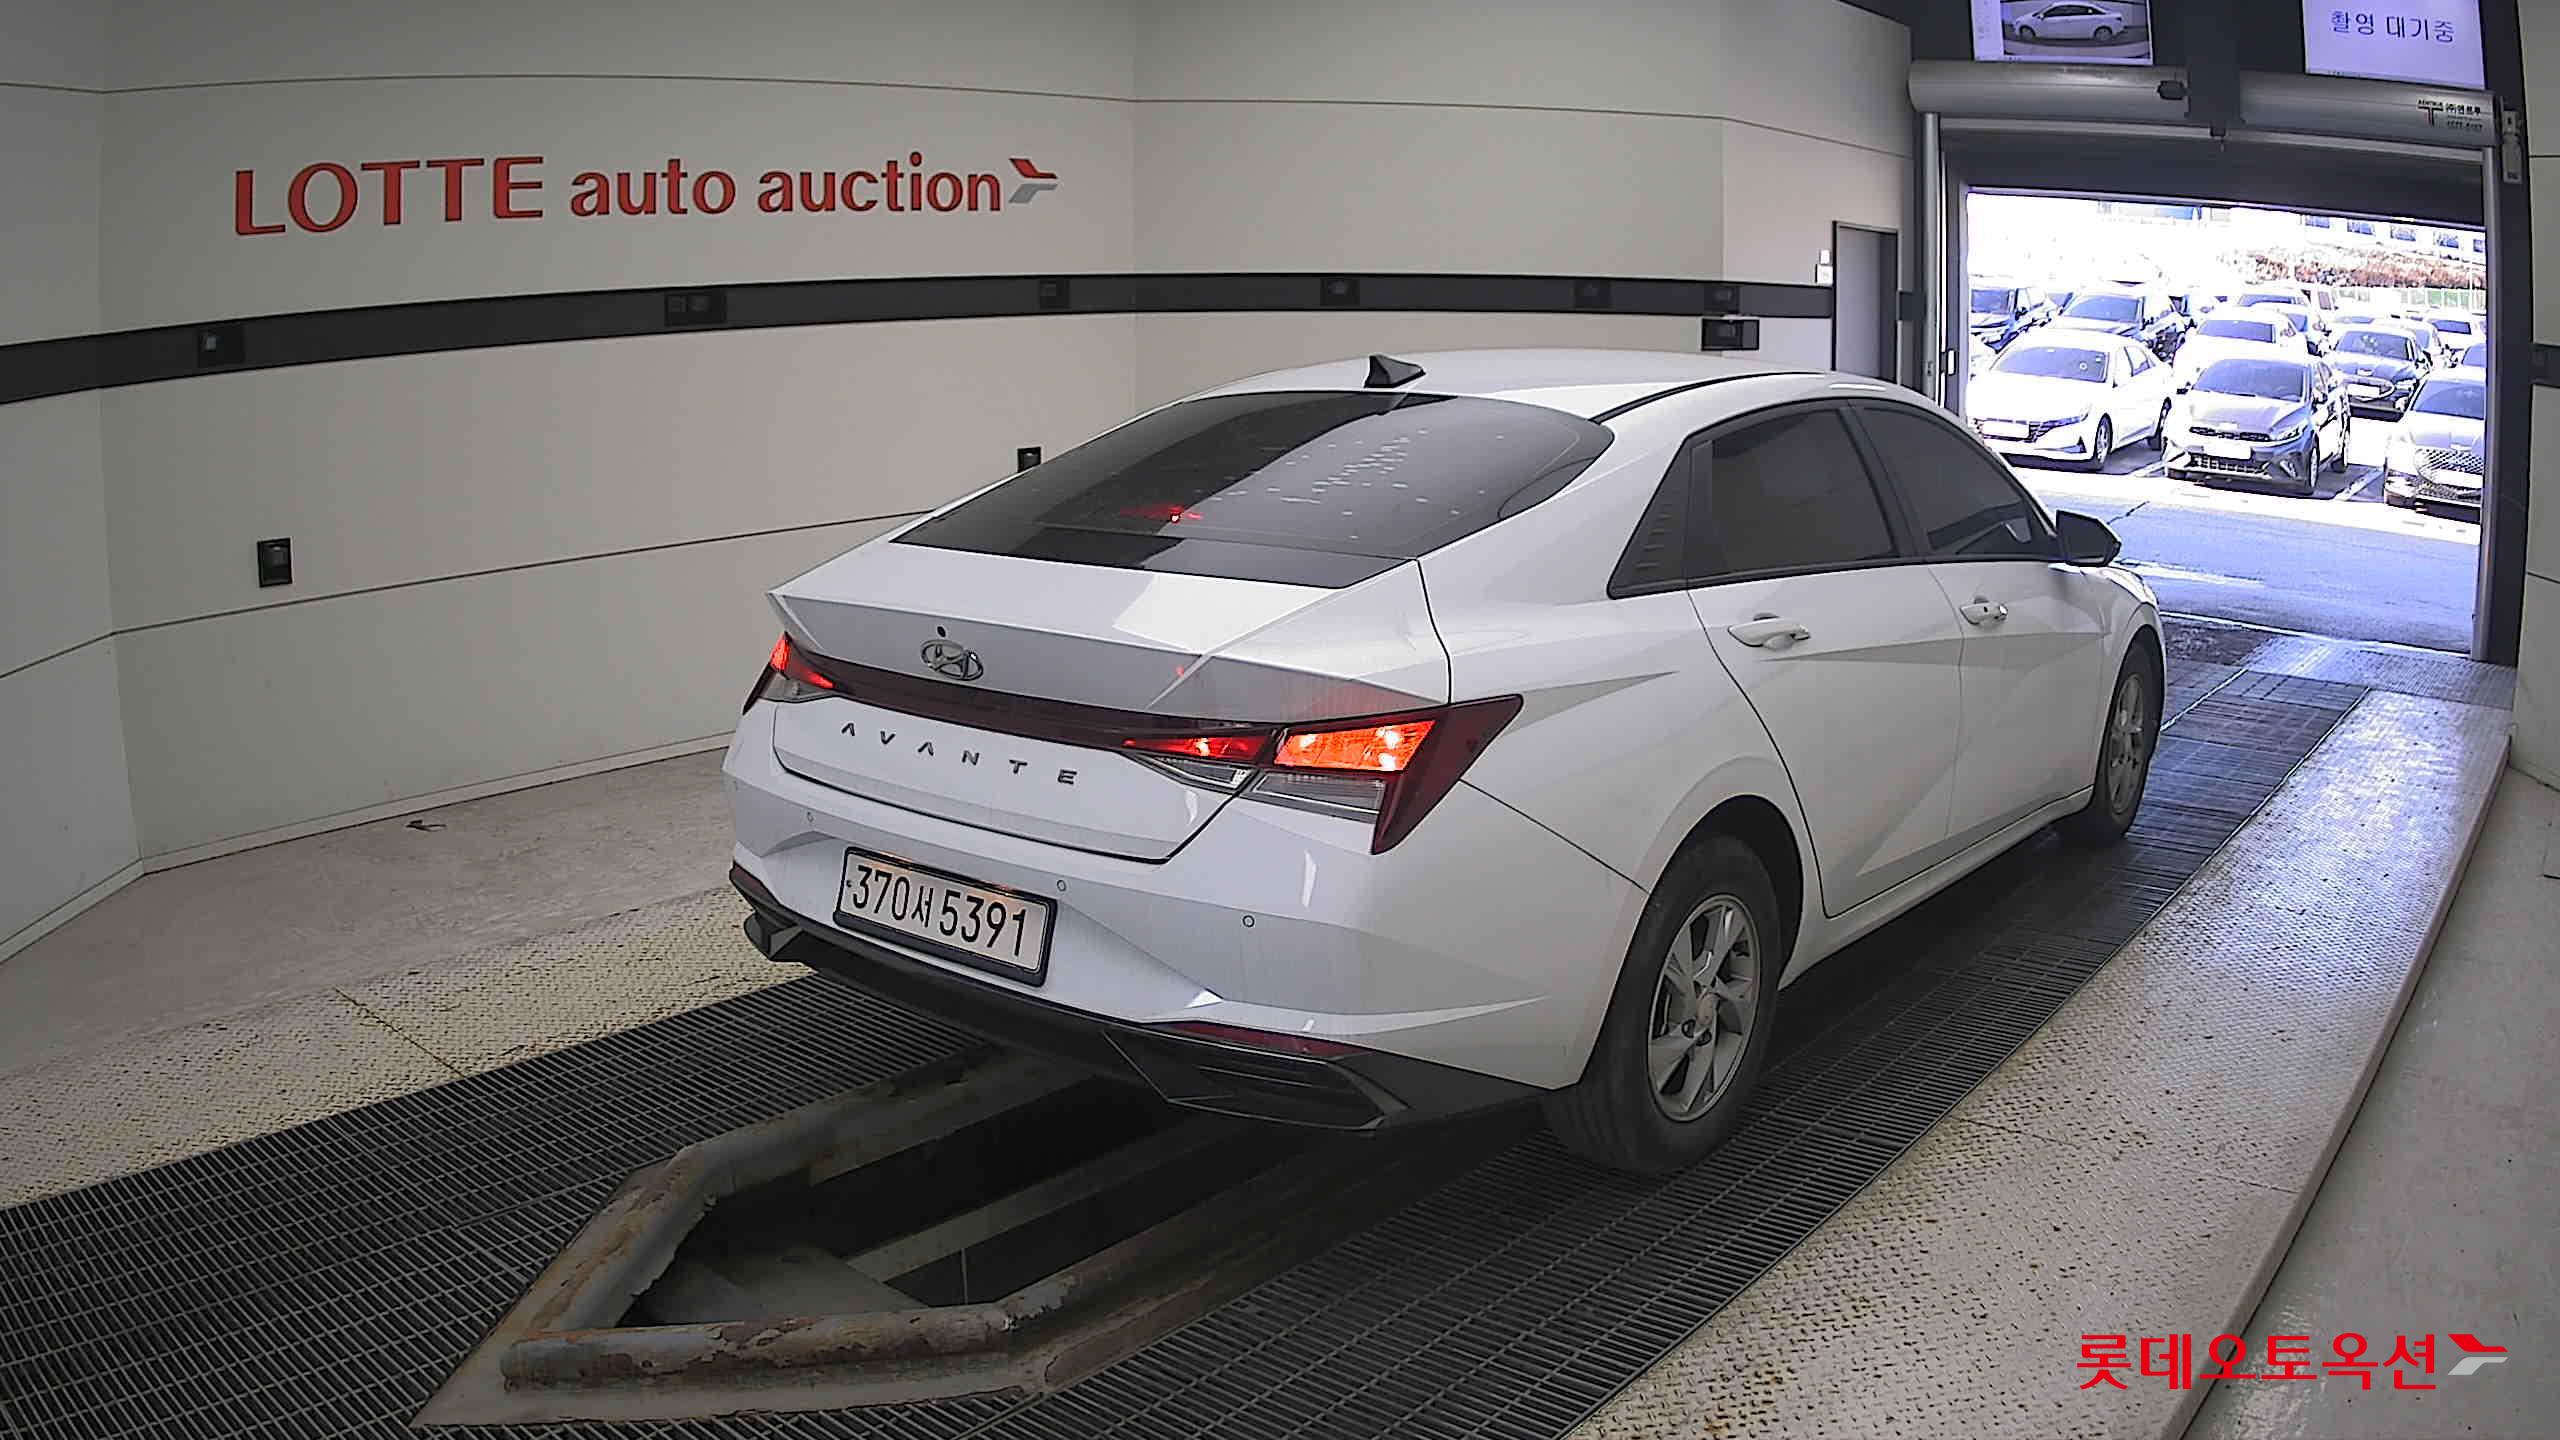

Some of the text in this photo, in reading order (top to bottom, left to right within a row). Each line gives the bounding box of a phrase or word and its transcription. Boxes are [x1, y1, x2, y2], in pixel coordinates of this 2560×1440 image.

[2331, 10, 2454, 43] 촬영 대기중
[236, 151, 1003, 236] LOTTE auto auction
[841, 721, 1078, 787] AVANTE
